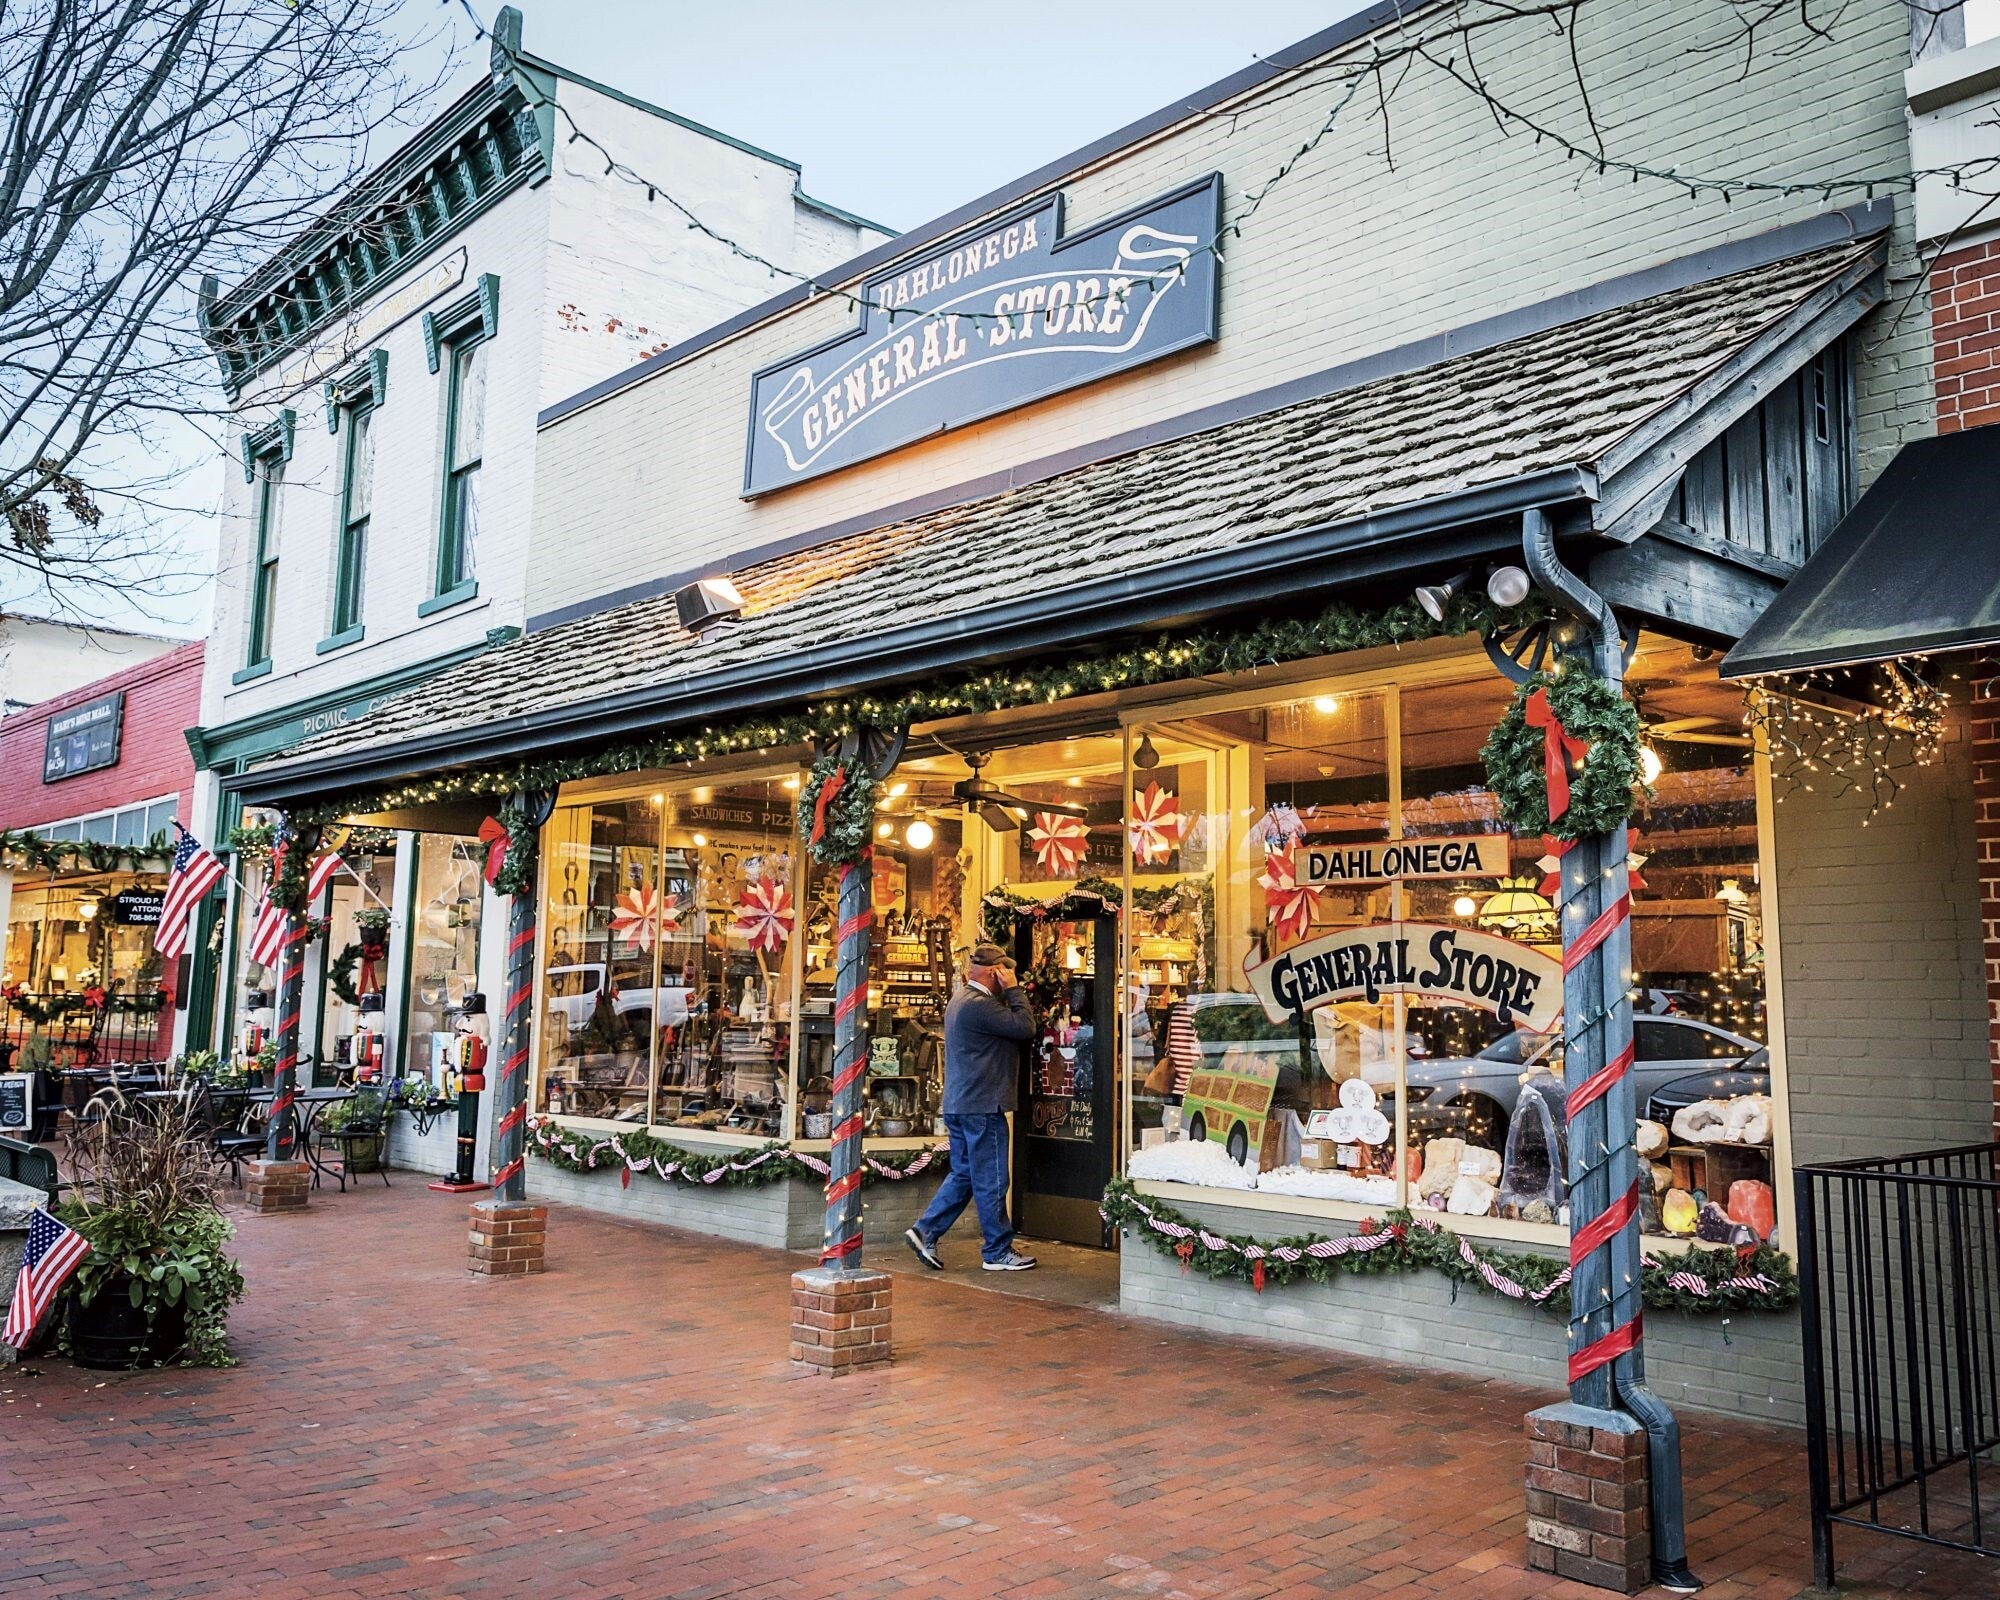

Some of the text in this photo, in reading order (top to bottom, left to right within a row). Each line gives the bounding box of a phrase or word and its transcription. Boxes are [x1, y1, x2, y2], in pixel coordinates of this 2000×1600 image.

[877, 217, 1038, 315] DAHLONEGA
[802, 275, 1134, 451] GENERAL STORE
[91, 704, 112, 721] MALL
[303, 708, 348, 734] PICNIC
[691, 807, 793, 827] SANDWICHES PIZZ
[718, 839, 739, 850] makes
[740, 844, 751, 852] you
[752, 843, 764, 851] feel
[1309, 842, 1483, 880] DAHLONEGA
[119, 896, 152, 904] STROUD
[132, 905, 162, 913] ATTORN
[1271, 929, 1542, 1025] GENERAL STORE
